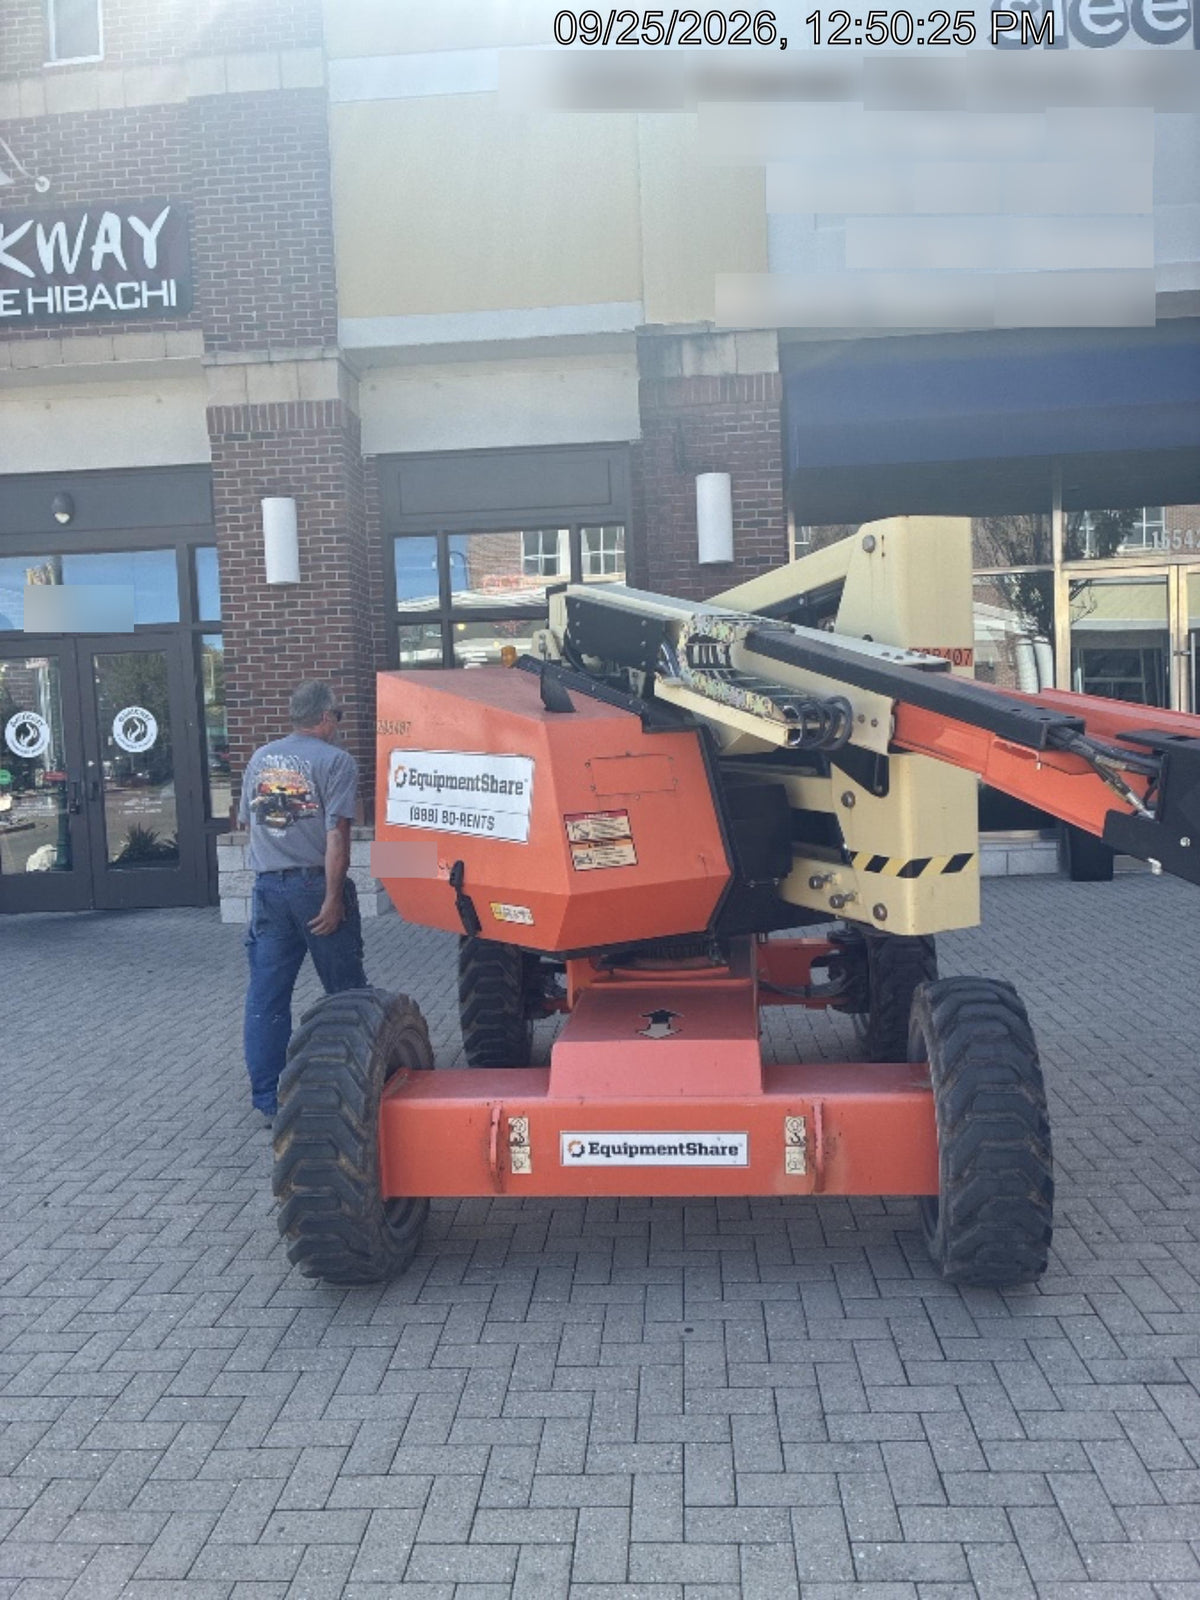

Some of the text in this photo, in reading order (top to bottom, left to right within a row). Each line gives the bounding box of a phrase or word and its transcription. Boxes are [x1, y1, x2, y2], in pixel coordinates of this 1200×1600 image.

[0, 205, 171, 278] KWAY
[27, 279, 177, 315] HIBACHI
[408, 768, 524, 796] EquipmentShare
[410, 805, 438, 824] (888)
[588, 1142, 738, 1158] EquipmentShare
